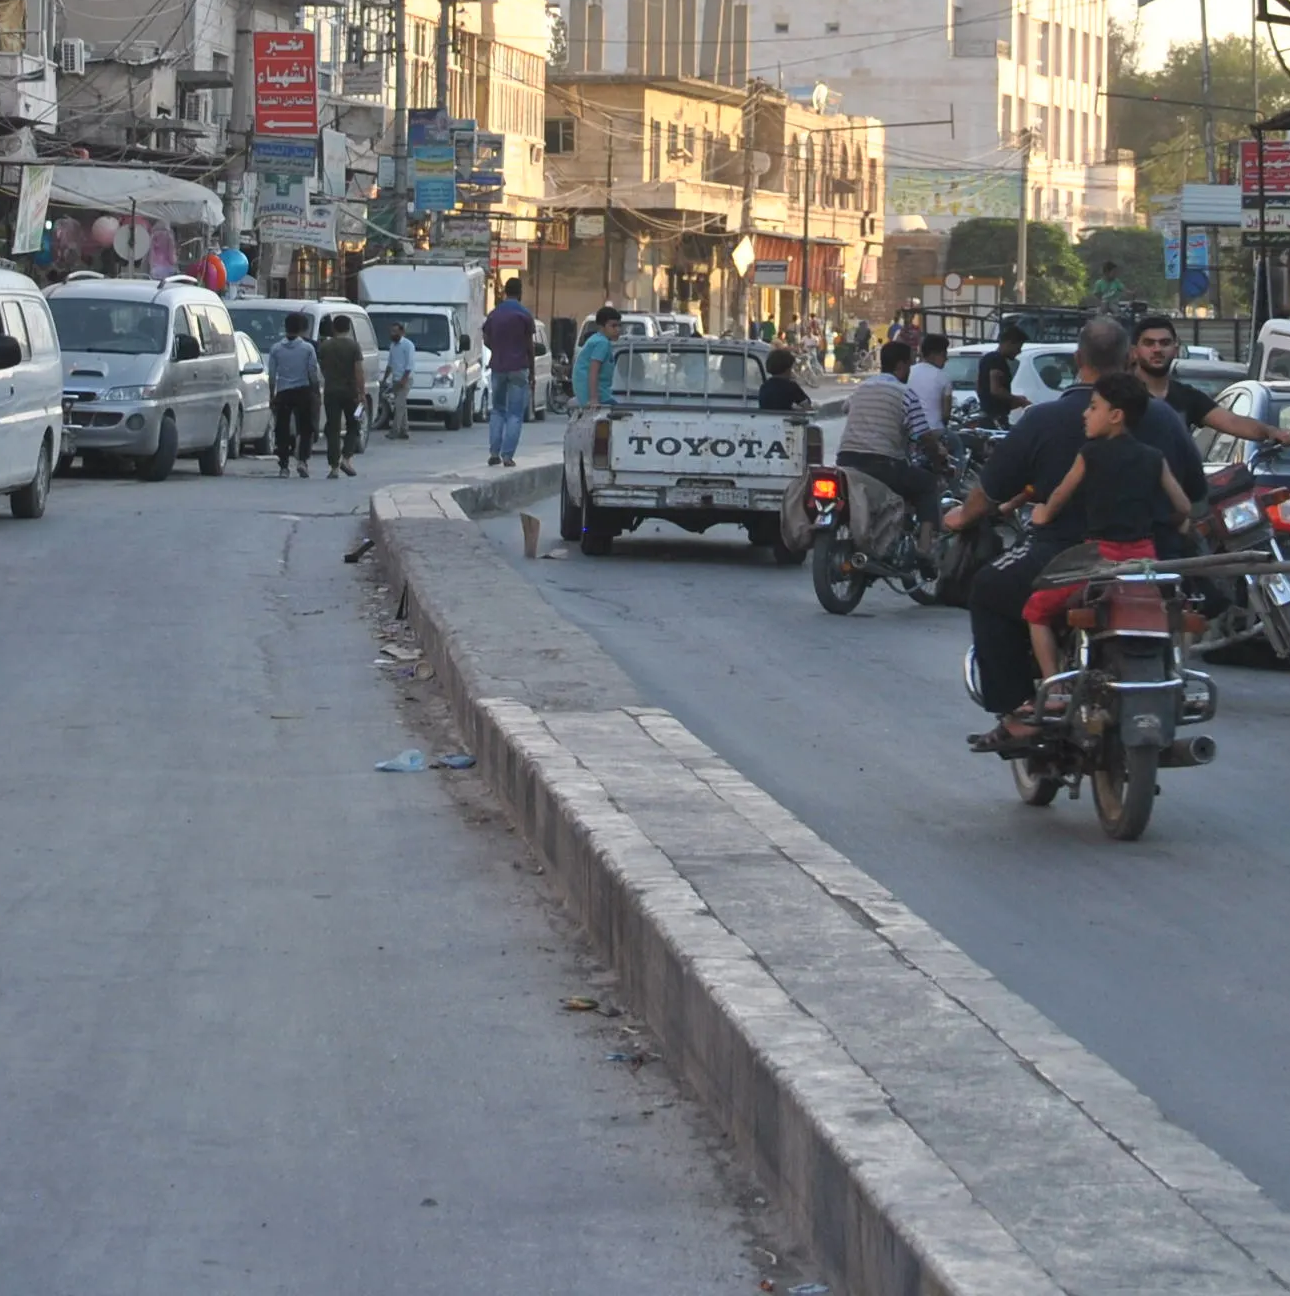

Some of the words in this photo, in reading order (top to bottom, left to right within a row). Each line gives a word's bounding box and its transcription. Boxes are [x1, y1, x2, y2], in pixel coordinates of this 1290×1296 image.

[265, 35, 304, 57] مخبر
[257, 62, 313, 88] الشهباء
[628, 436, 790, 460] TOYOTA
